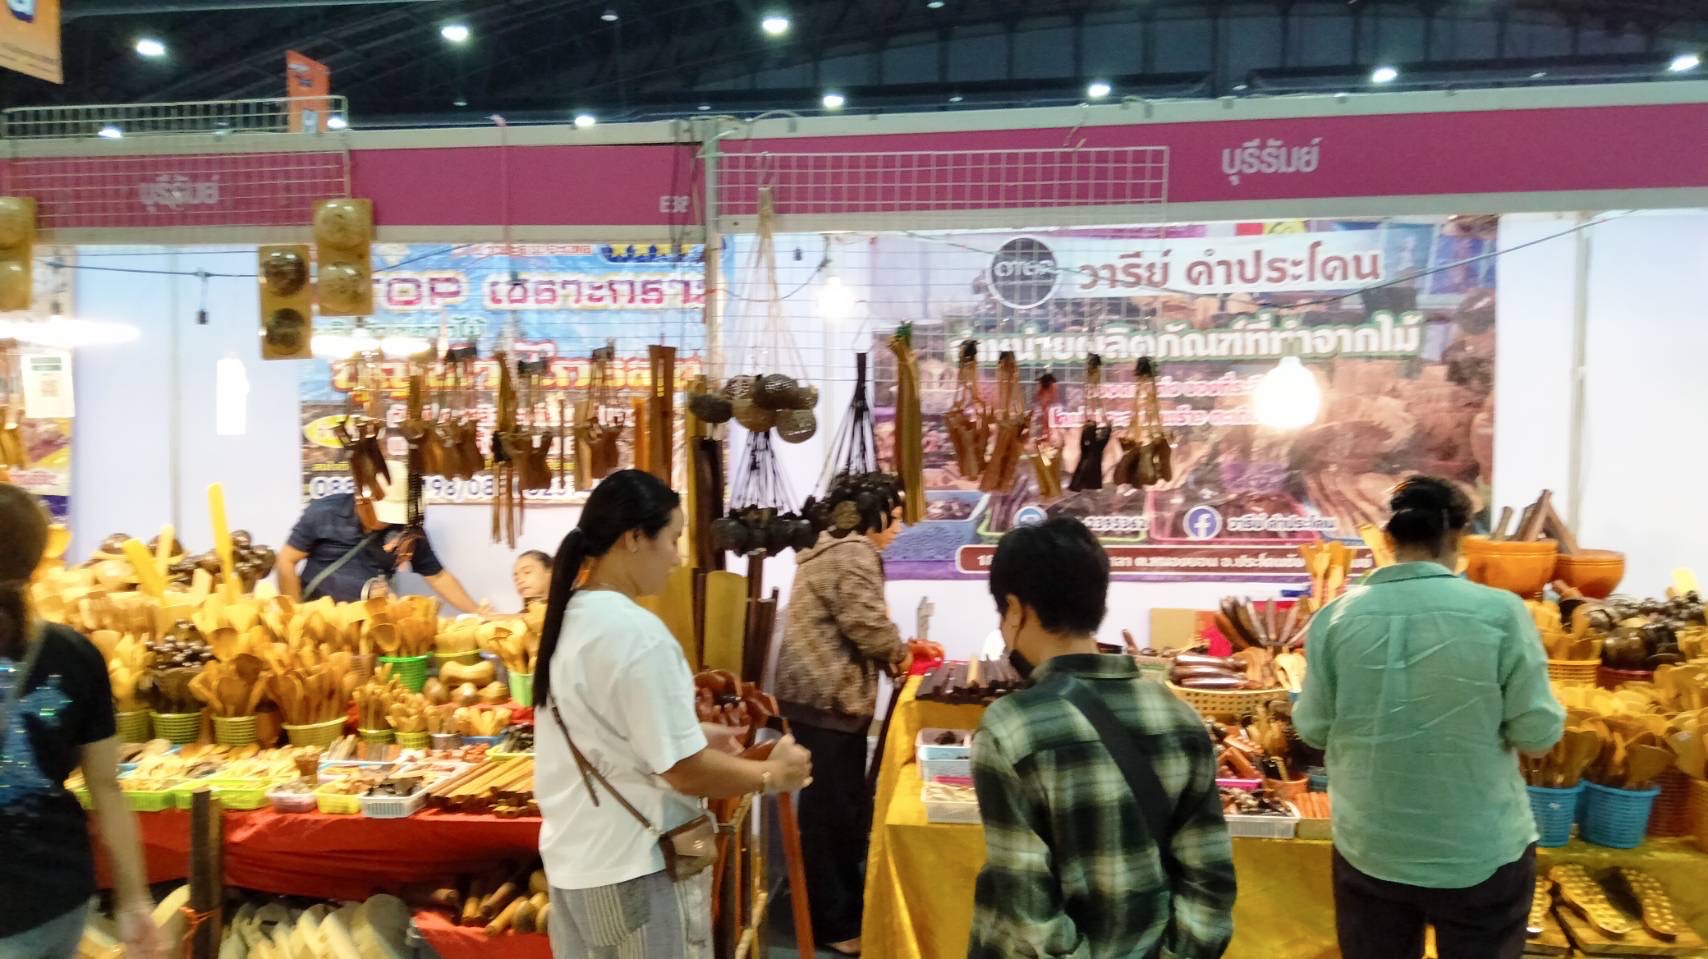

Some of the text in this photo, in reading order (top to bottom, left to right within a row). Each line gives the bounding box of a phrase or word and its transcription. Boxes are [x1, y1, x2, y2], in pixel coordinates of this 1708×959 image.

[1222, 137, 1323, 186] บุรีรัมย์
[1079, 249, 1172, 290] วารีย์
